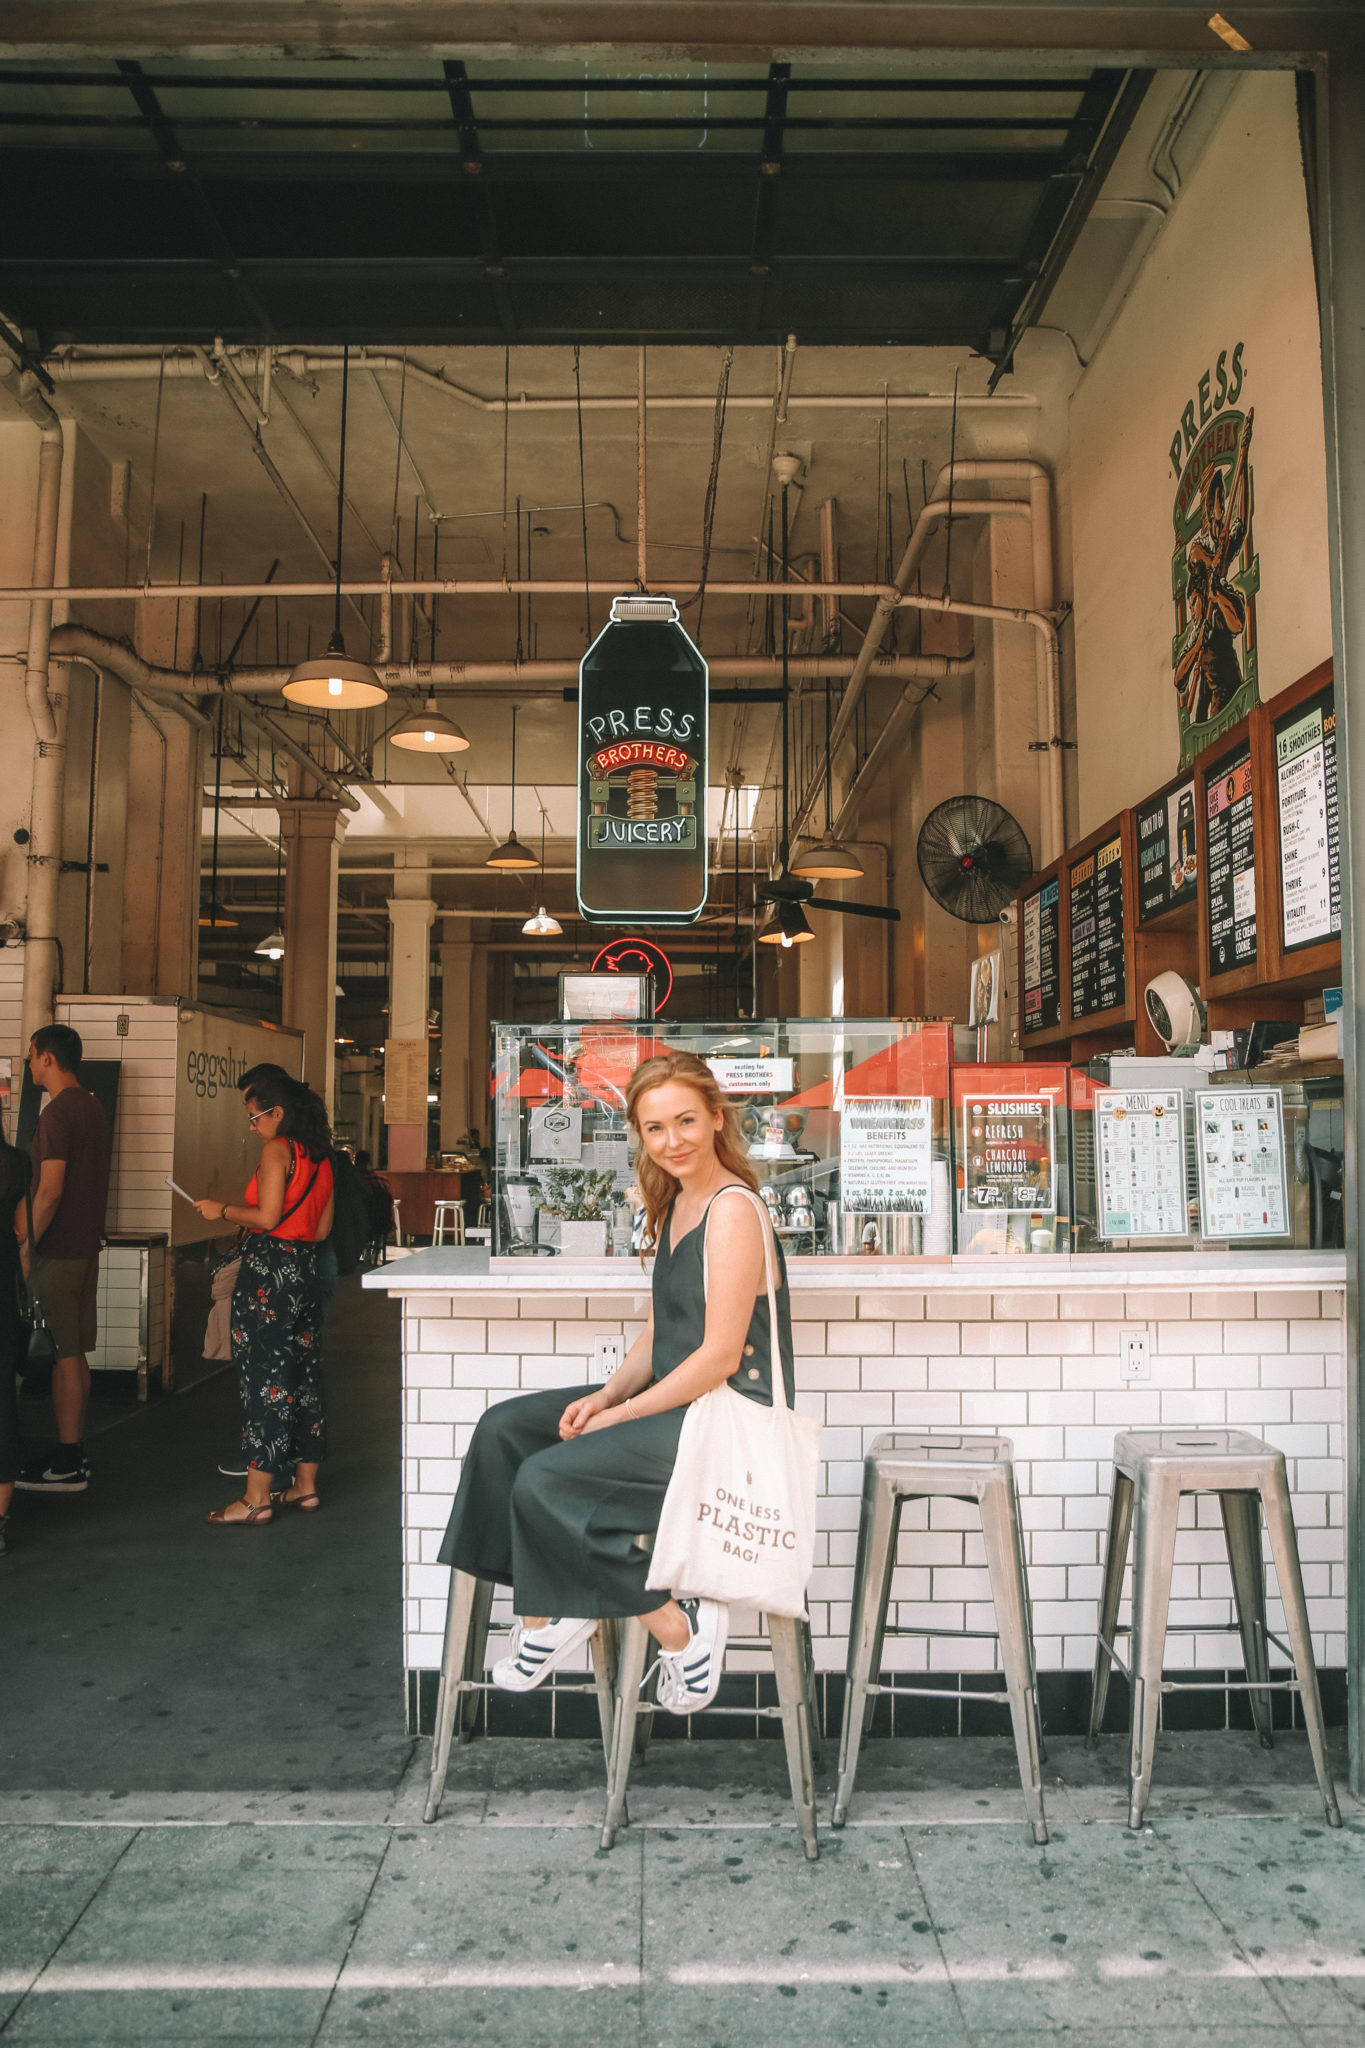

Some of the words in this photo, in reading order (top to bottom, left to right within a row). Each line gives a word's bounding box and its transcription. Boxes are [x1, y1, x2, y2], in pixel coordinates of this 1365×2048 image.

[1169, 341, 1245, 481] PRESS
[589, 706, 695, 741] PRESS
[1278, 738, 1288, 757] 16
[1289, 724, 1321, 753] SMOOTHIES
[597, 743, 688, 768] BROTHERS
[1281, 759, 1305, 781] ALCHEMIST
[1313, 751, 1320, 762] 10
[1228, 781, 1234, 799] 4
[1281, 787, 1307, 809] FORTITUDE
[1318, 779, 1322, 790] 9
[1209, 804, 1219, 817] POPS
[598, 817, 686, 843] JUICERY
[1283, 819, 1300, 836] RUSH-C
[1319, 808, 1323, 819] 9
[1098, 848, 1115, 869] SHOTS
[1284, 848, 1298, 864] SHINE
[1317, 837, 1325, 848] 10
[1220, 863, 1230, 877] GOLD
[1285, 876, 1302, 892] THRIVE
[1321, 867, 1326, 878] 9
[1211, 894, 1223, 909] SPLASH
[1286, 904, 1307, 921] VITALITY
[1320, 898, 1327, 909] 11
[187, 1046, 248, 1099] eggslut
[758, 1080, 771, 1088] only
[987, 1102, 1043, 1115] SLUSHIES
[1125, 1095, 1150, 1110] MENU
[1219, 1098, 1237, 1112] COOL
[1239, 1097, 1261, 1111] TREATS
[849, 1117, 926, 1130] WHEATGRASS
[985, 1125, 1023, 1139] REFRESH
[866, 1131, 907, 1140] BENEFITS
[985, 1148, 1027, 1161] CHARCOAL
[985, 1161, 1028, 1173] LEMONADE
[846, 1188, 850, 1196] 1
[888, 1188, 894, 1196] 2
[907, 1188, 927, 1196] $4.00
[715, 1487, 745, 1511] ONE
[749, 1502, 781, 1521] LESS
[697, 1502, 796, 1550] PLASTIC
[722, 1540, 759, 1564] BAG!
